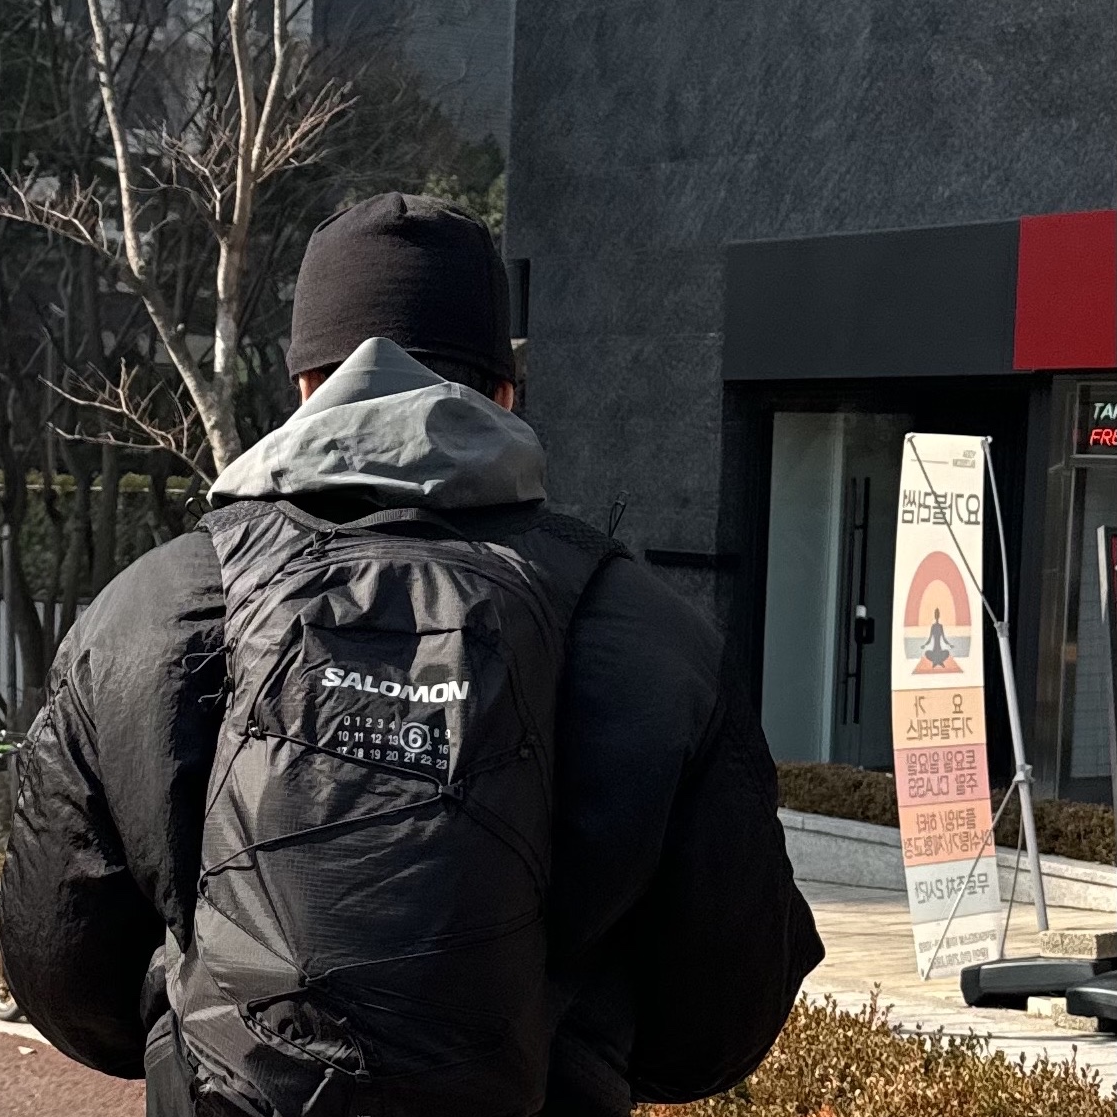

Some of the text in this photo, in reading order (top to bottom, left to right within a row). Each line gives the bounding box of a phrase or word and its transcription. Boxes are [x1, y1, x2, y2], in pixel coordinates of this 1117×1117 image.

[321, 667, 470, 703] SALOMON
[343, 716, 351, 725] 0
[355, 717, 361, 726] 1
[365, 718, 372, 727] 2
[377, 719, 384, 728] 3
[389, 720, 395, 730] 4
[433, 728, 440, 738] 8
[337, 731, 349, 741] 10
[354, 732, 364, 742] 11
[371, 734, 382, 744] 12
[388, 735, 399, 745] 13
[408, 728, 422, 748] 6
[353, 748, 364, 758] 18
[369, 749, 381, 760] 19
[386, 750, 398, 761] 20
[404, 752, 415, 762] 21
[420, 754, 432, 766] 22
[436, 759, 448, 769] 23
